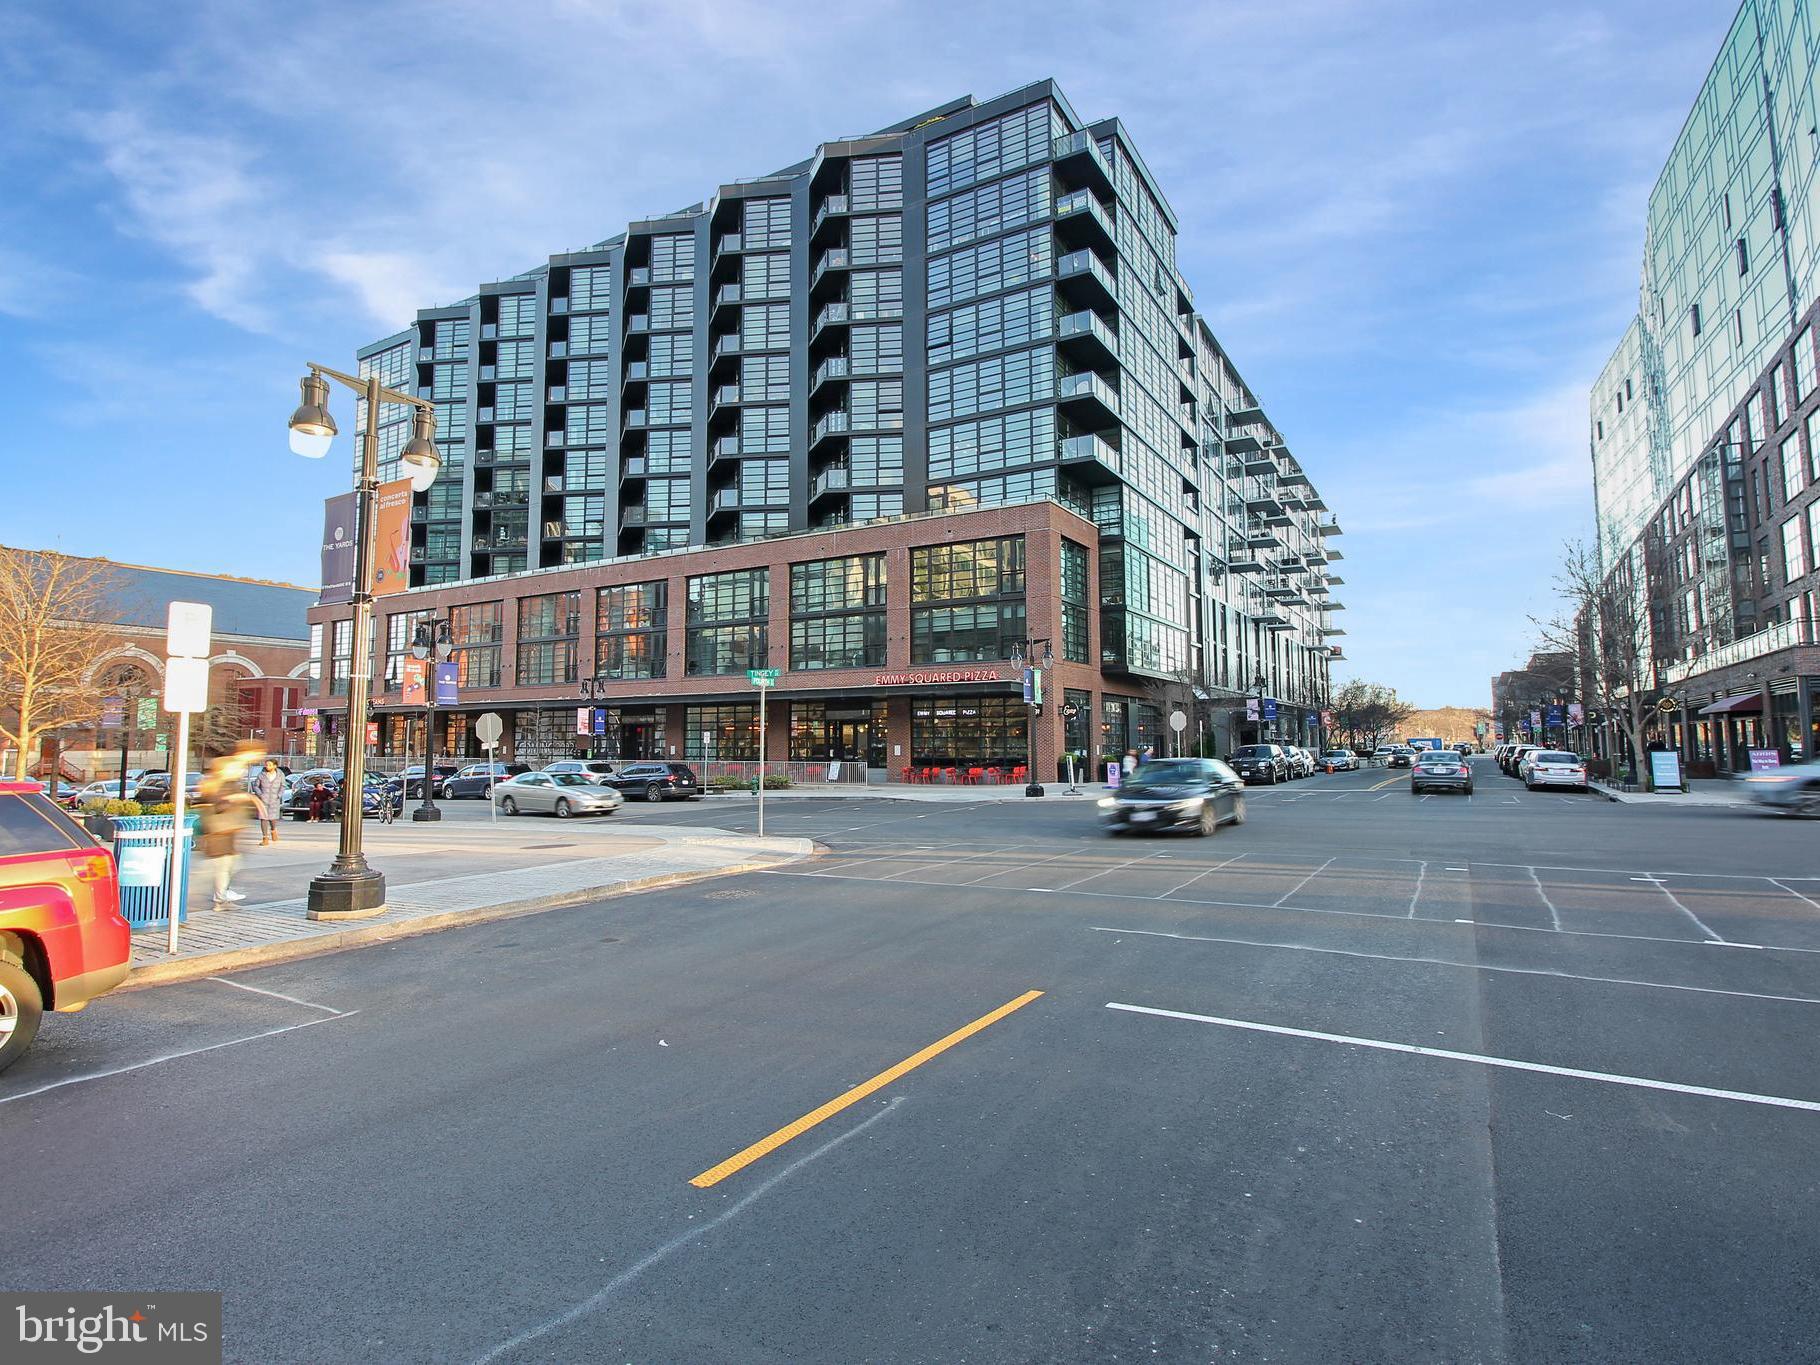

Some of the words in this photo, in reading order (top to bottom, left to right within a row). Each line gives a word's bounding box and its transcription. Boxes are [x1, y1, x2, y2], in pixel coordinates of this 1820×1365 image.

[335, 540, 353, 549] YARDS
[875, 674, 908, 685] EMMY
[909, 672, 960, 683] SQUARED
[964, 670, 997, 681] PIZZA
